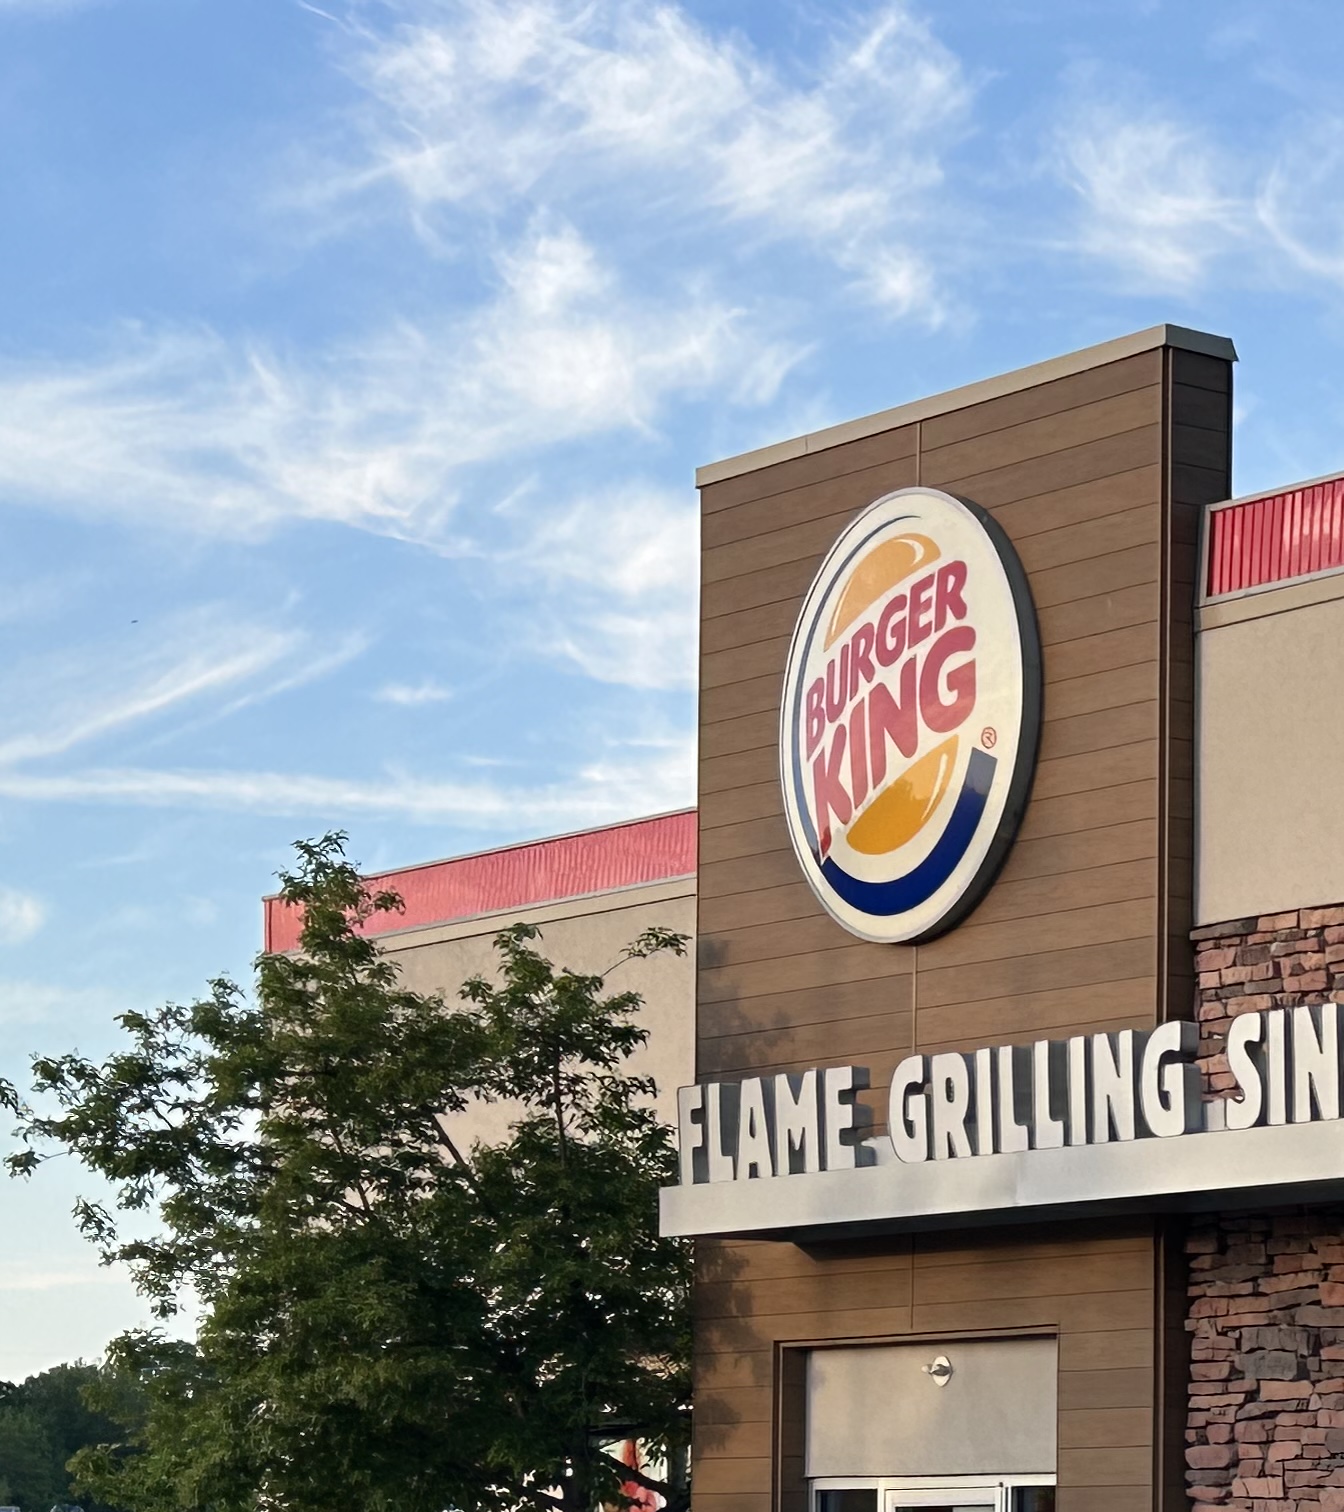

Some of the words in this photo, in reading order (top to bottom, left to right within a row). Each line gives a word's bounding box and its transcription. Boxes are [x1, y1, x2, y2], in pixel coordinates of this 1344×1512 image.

[806, 560, 968, 758] BURGER
[811, 625, 977, 864] KING
[677, 1066, 857, 1186] FLAME
[888, 1020, 1186, 1164] GRILLING
